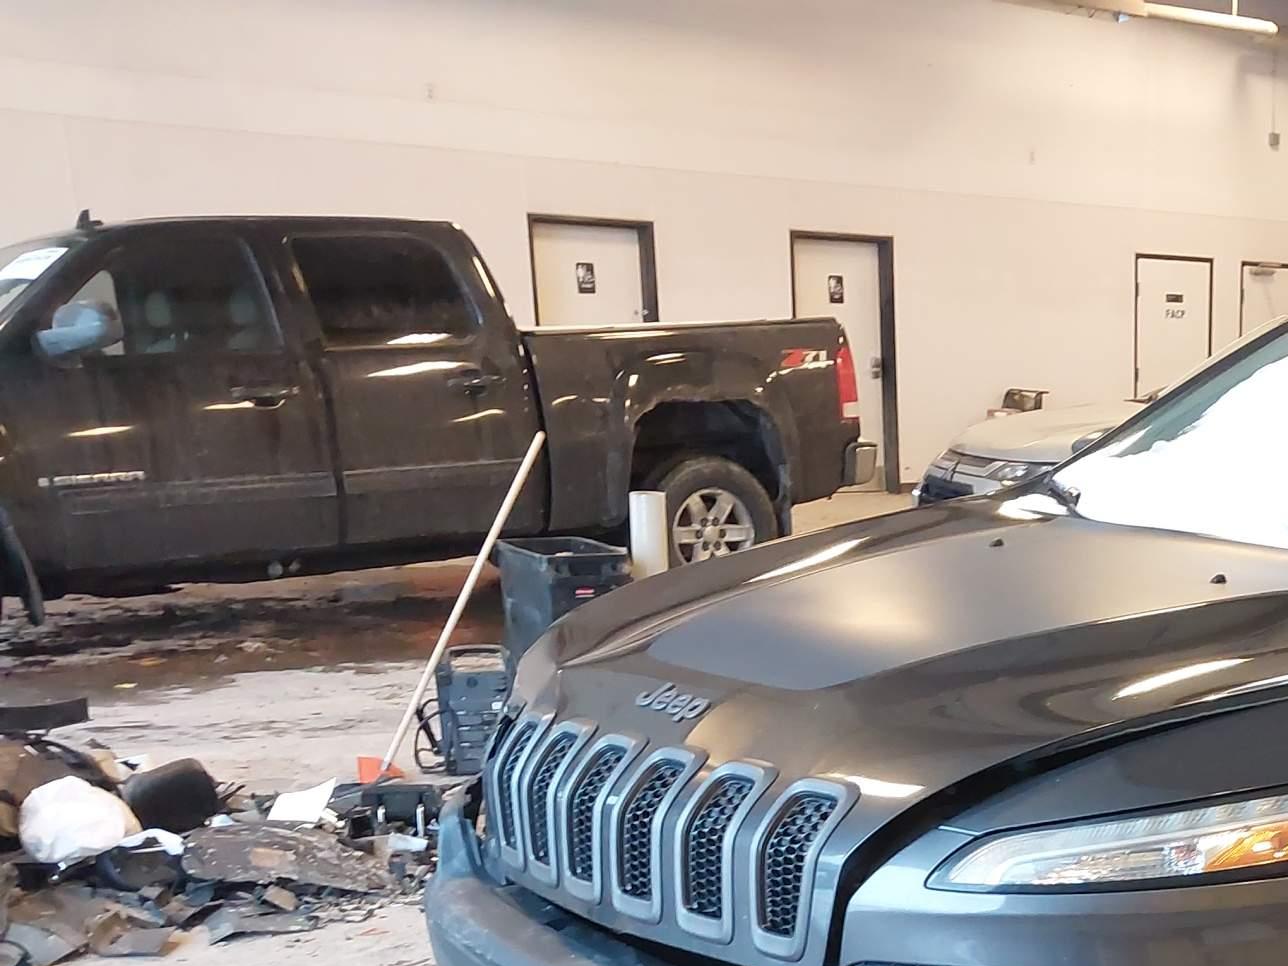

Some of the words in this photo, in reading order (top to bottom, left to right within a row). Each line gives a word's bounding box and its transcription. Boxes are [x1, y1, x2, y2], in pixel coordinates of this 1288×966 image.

[781, 350, 828, 368] Z71
[53, 471, 145, 486] SIERRA
[636, 682, 711, 722] Jeep
